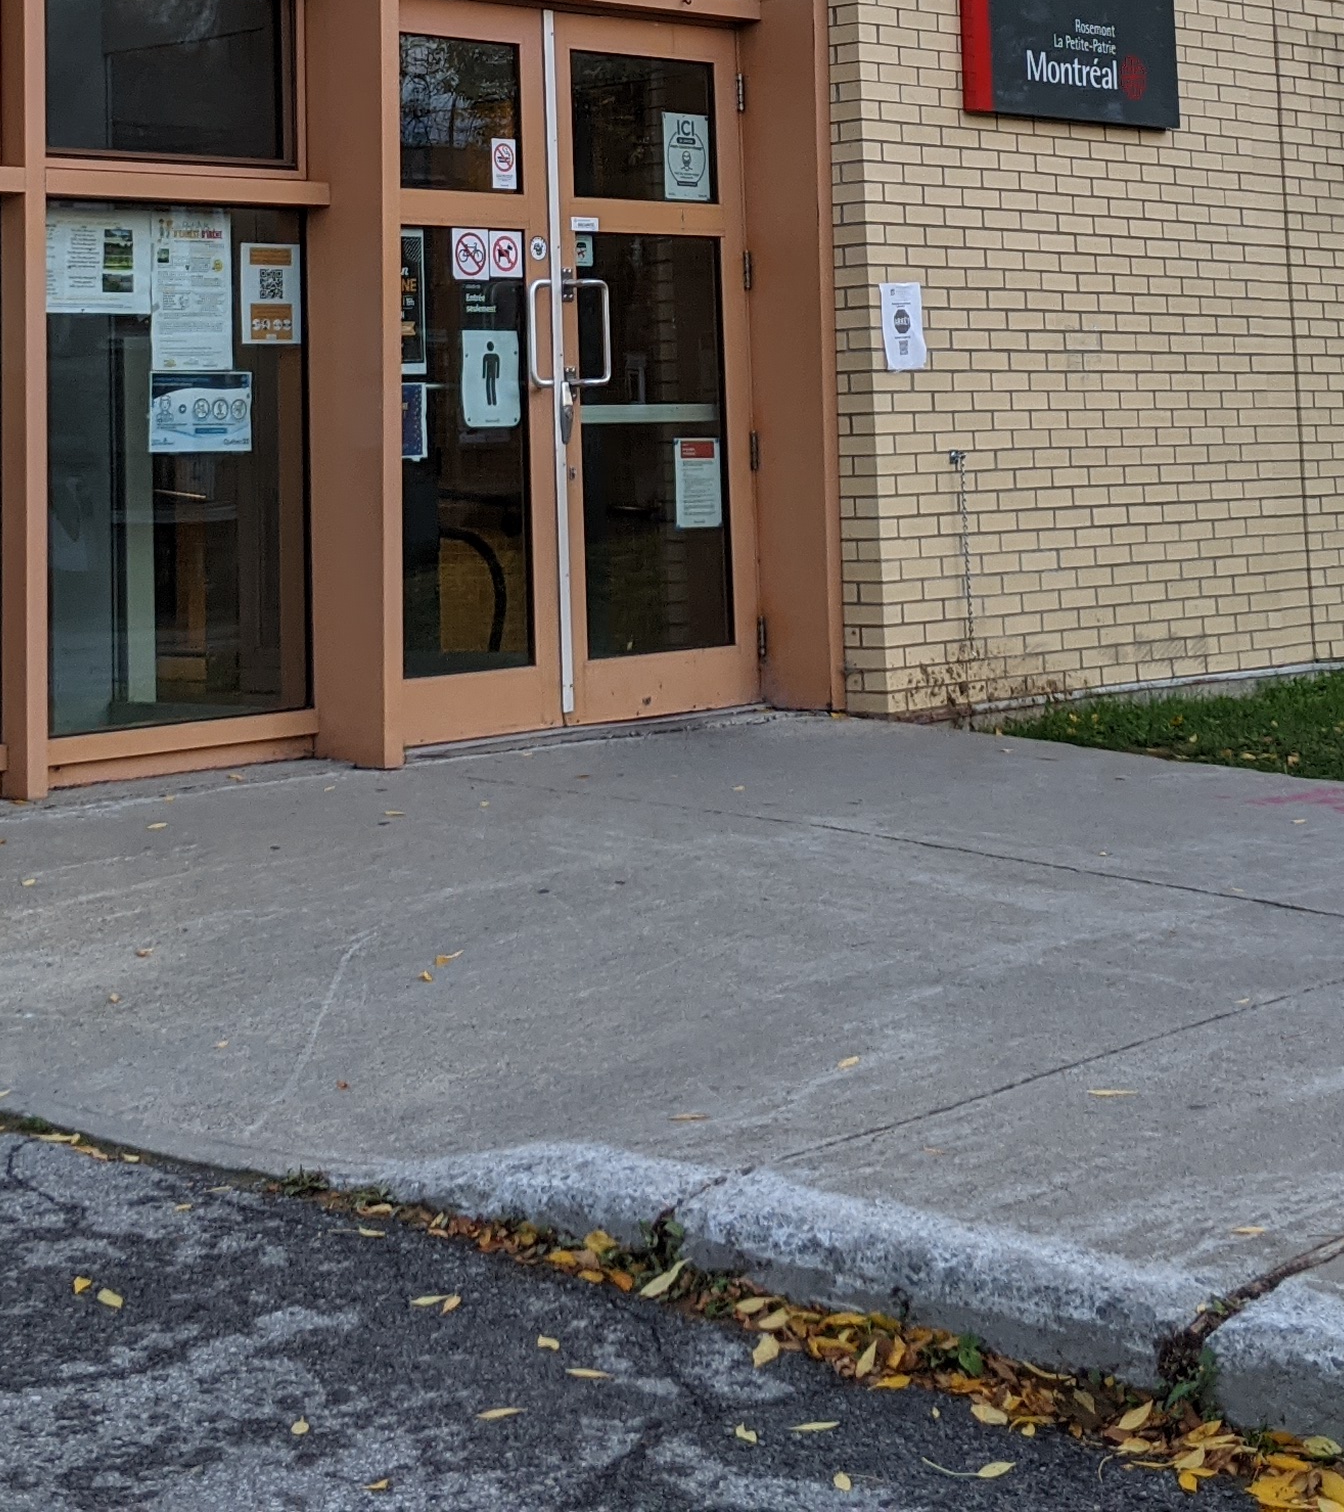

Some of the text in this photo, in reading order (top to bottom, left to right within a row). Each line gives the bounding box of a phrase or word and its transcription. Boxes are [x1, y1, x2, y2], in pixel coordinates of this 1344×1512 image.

[1075, 18, 1116, 38] Rosemont
[1053, 33, 1116, 55] La Petite-Patrie
[1026, 49, 1118, 90] Montréal
[677, 119, 695, 137] ICI
